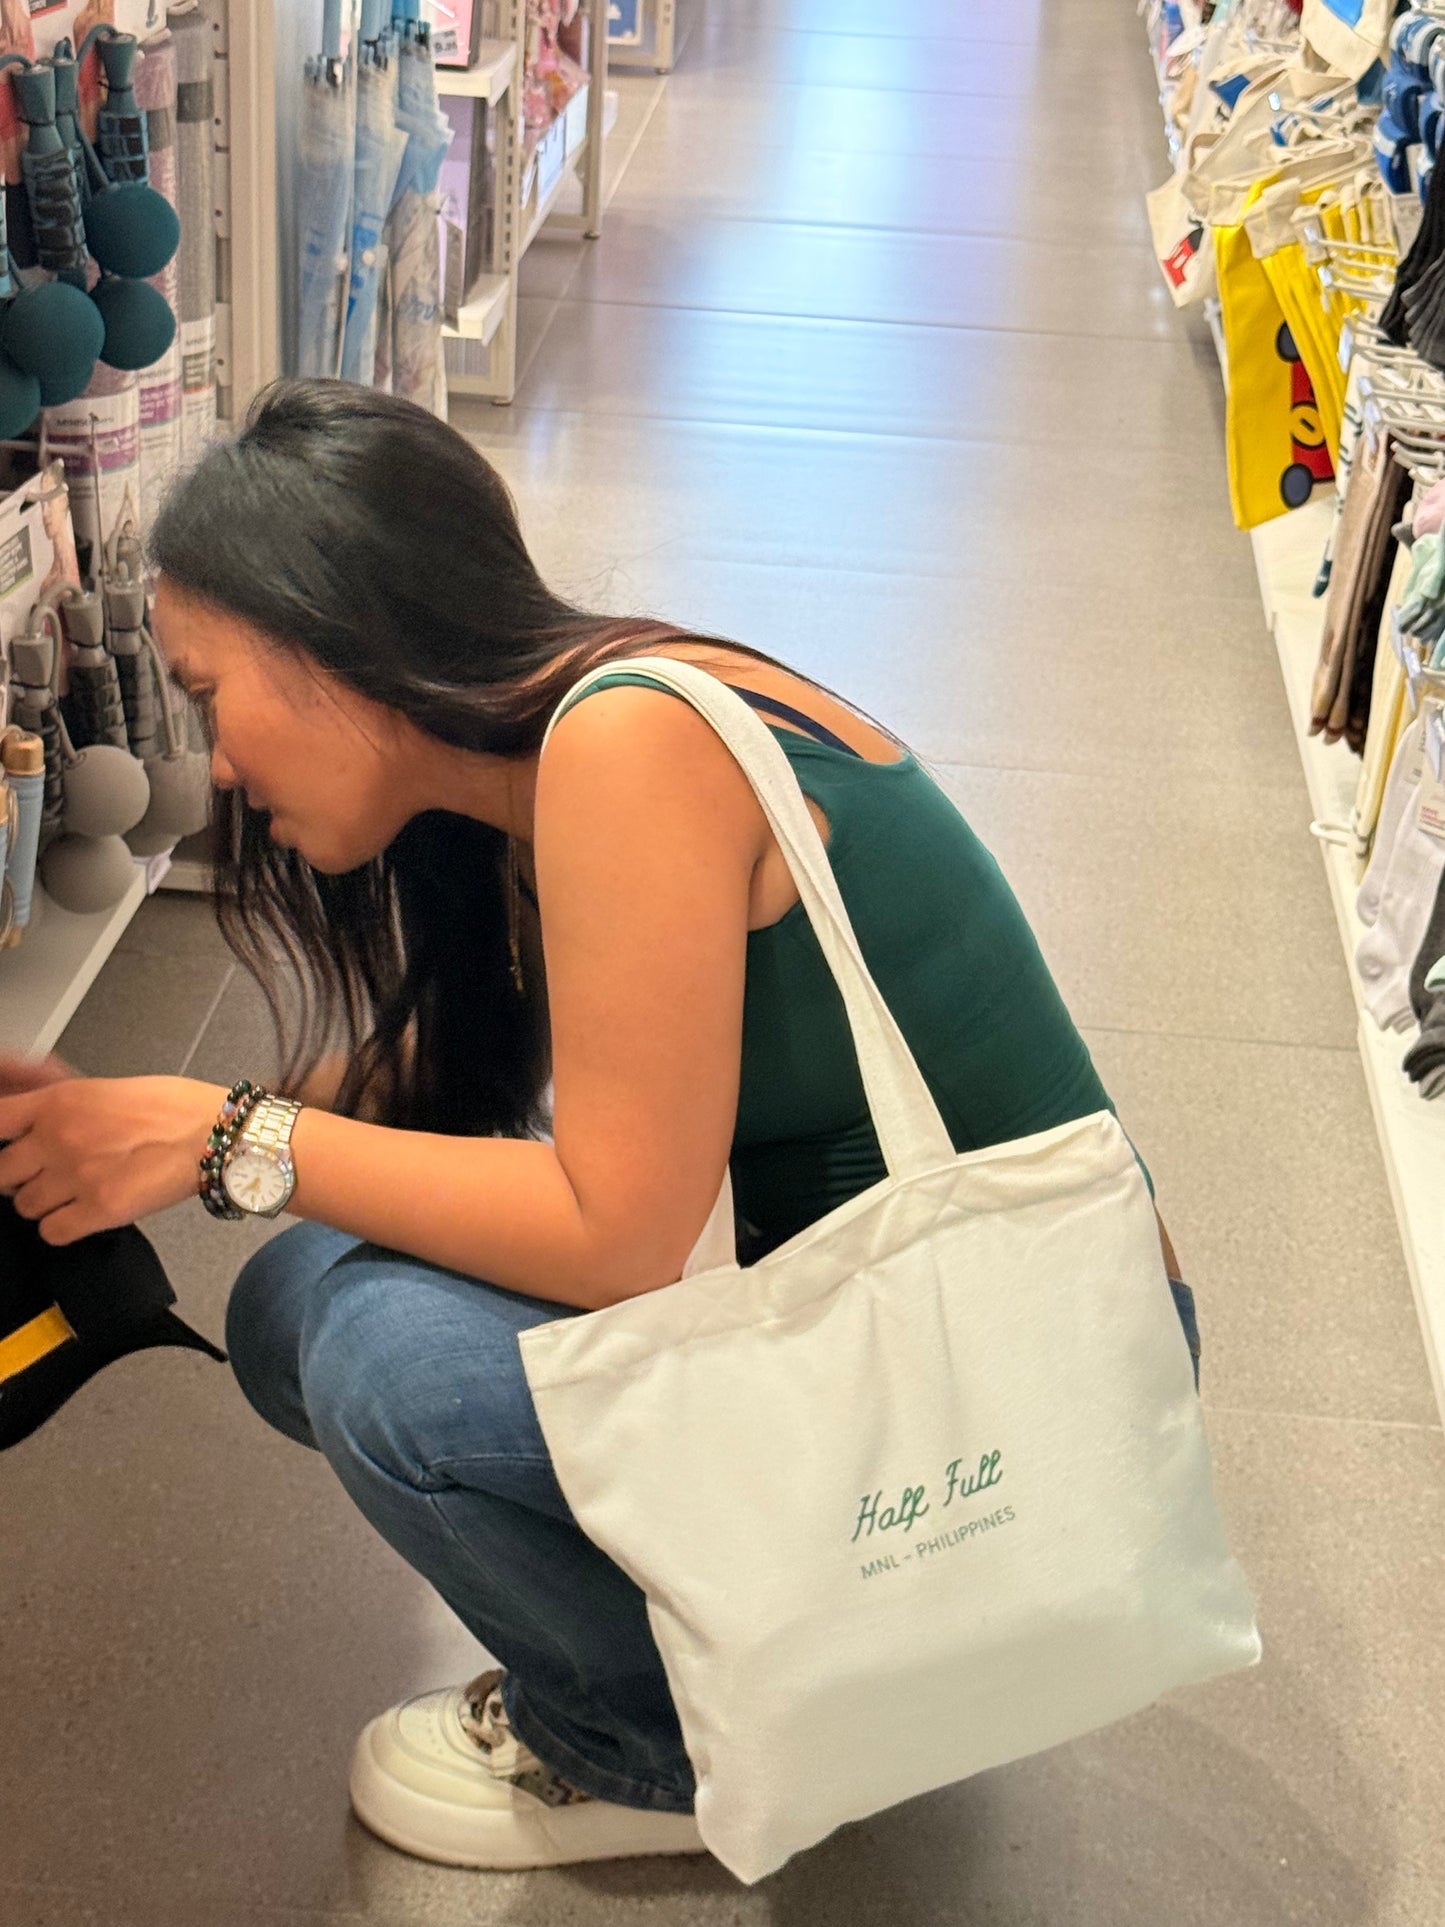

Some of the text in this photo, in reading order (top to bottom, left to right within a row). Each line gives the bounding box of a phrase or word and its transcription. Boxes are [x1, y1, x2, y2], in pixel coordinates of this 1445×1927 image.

[851, 1449, 1003, 1543] Half Full
[860, 1554, 900, 1579] MNL
[914, 1505, 1016, 1558] PHILIPPINES
